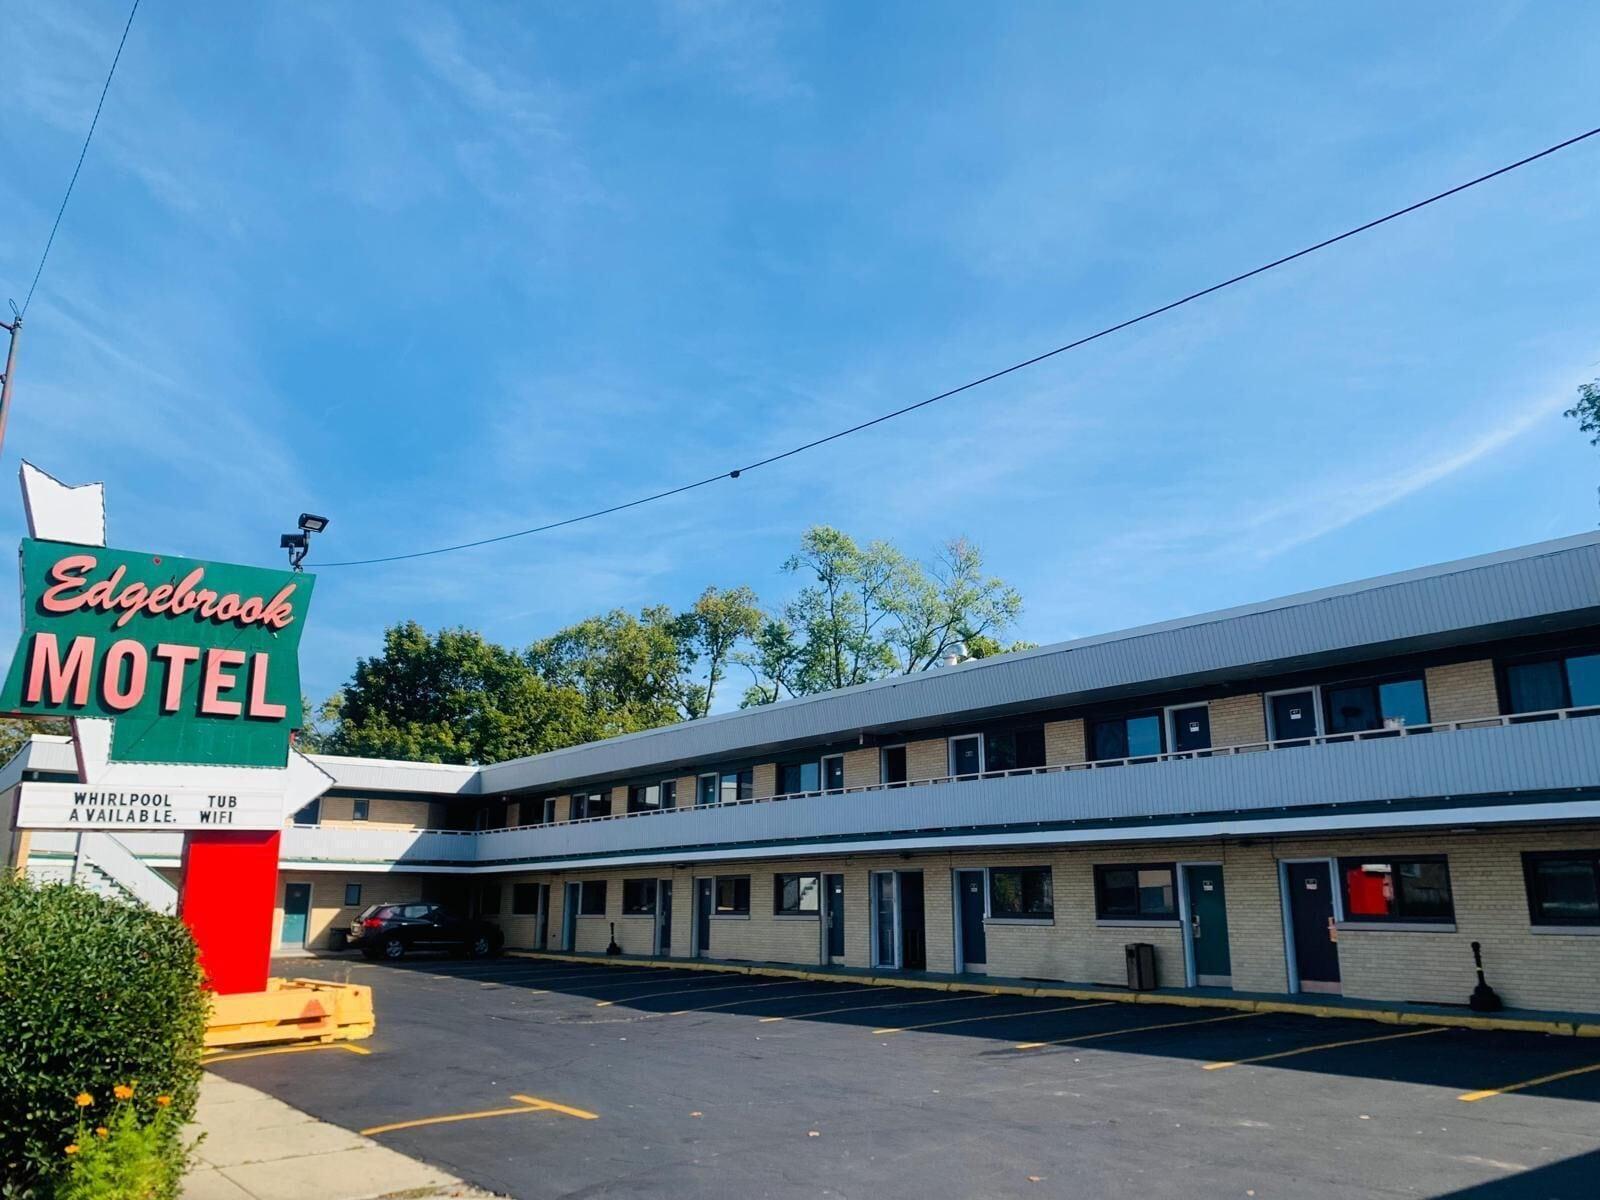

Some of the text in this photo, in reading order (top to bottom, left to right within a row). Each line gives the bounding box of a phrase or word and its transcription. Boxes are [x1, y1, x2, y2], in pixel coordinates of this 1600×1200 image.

[43, 555, 297, 629] Edgebrook
[27, 632, 287, 718] MOTEL
[74, 792, 237, 808] WHIRLPOOL TUB
[199, 811, 233, 824] WIFI
